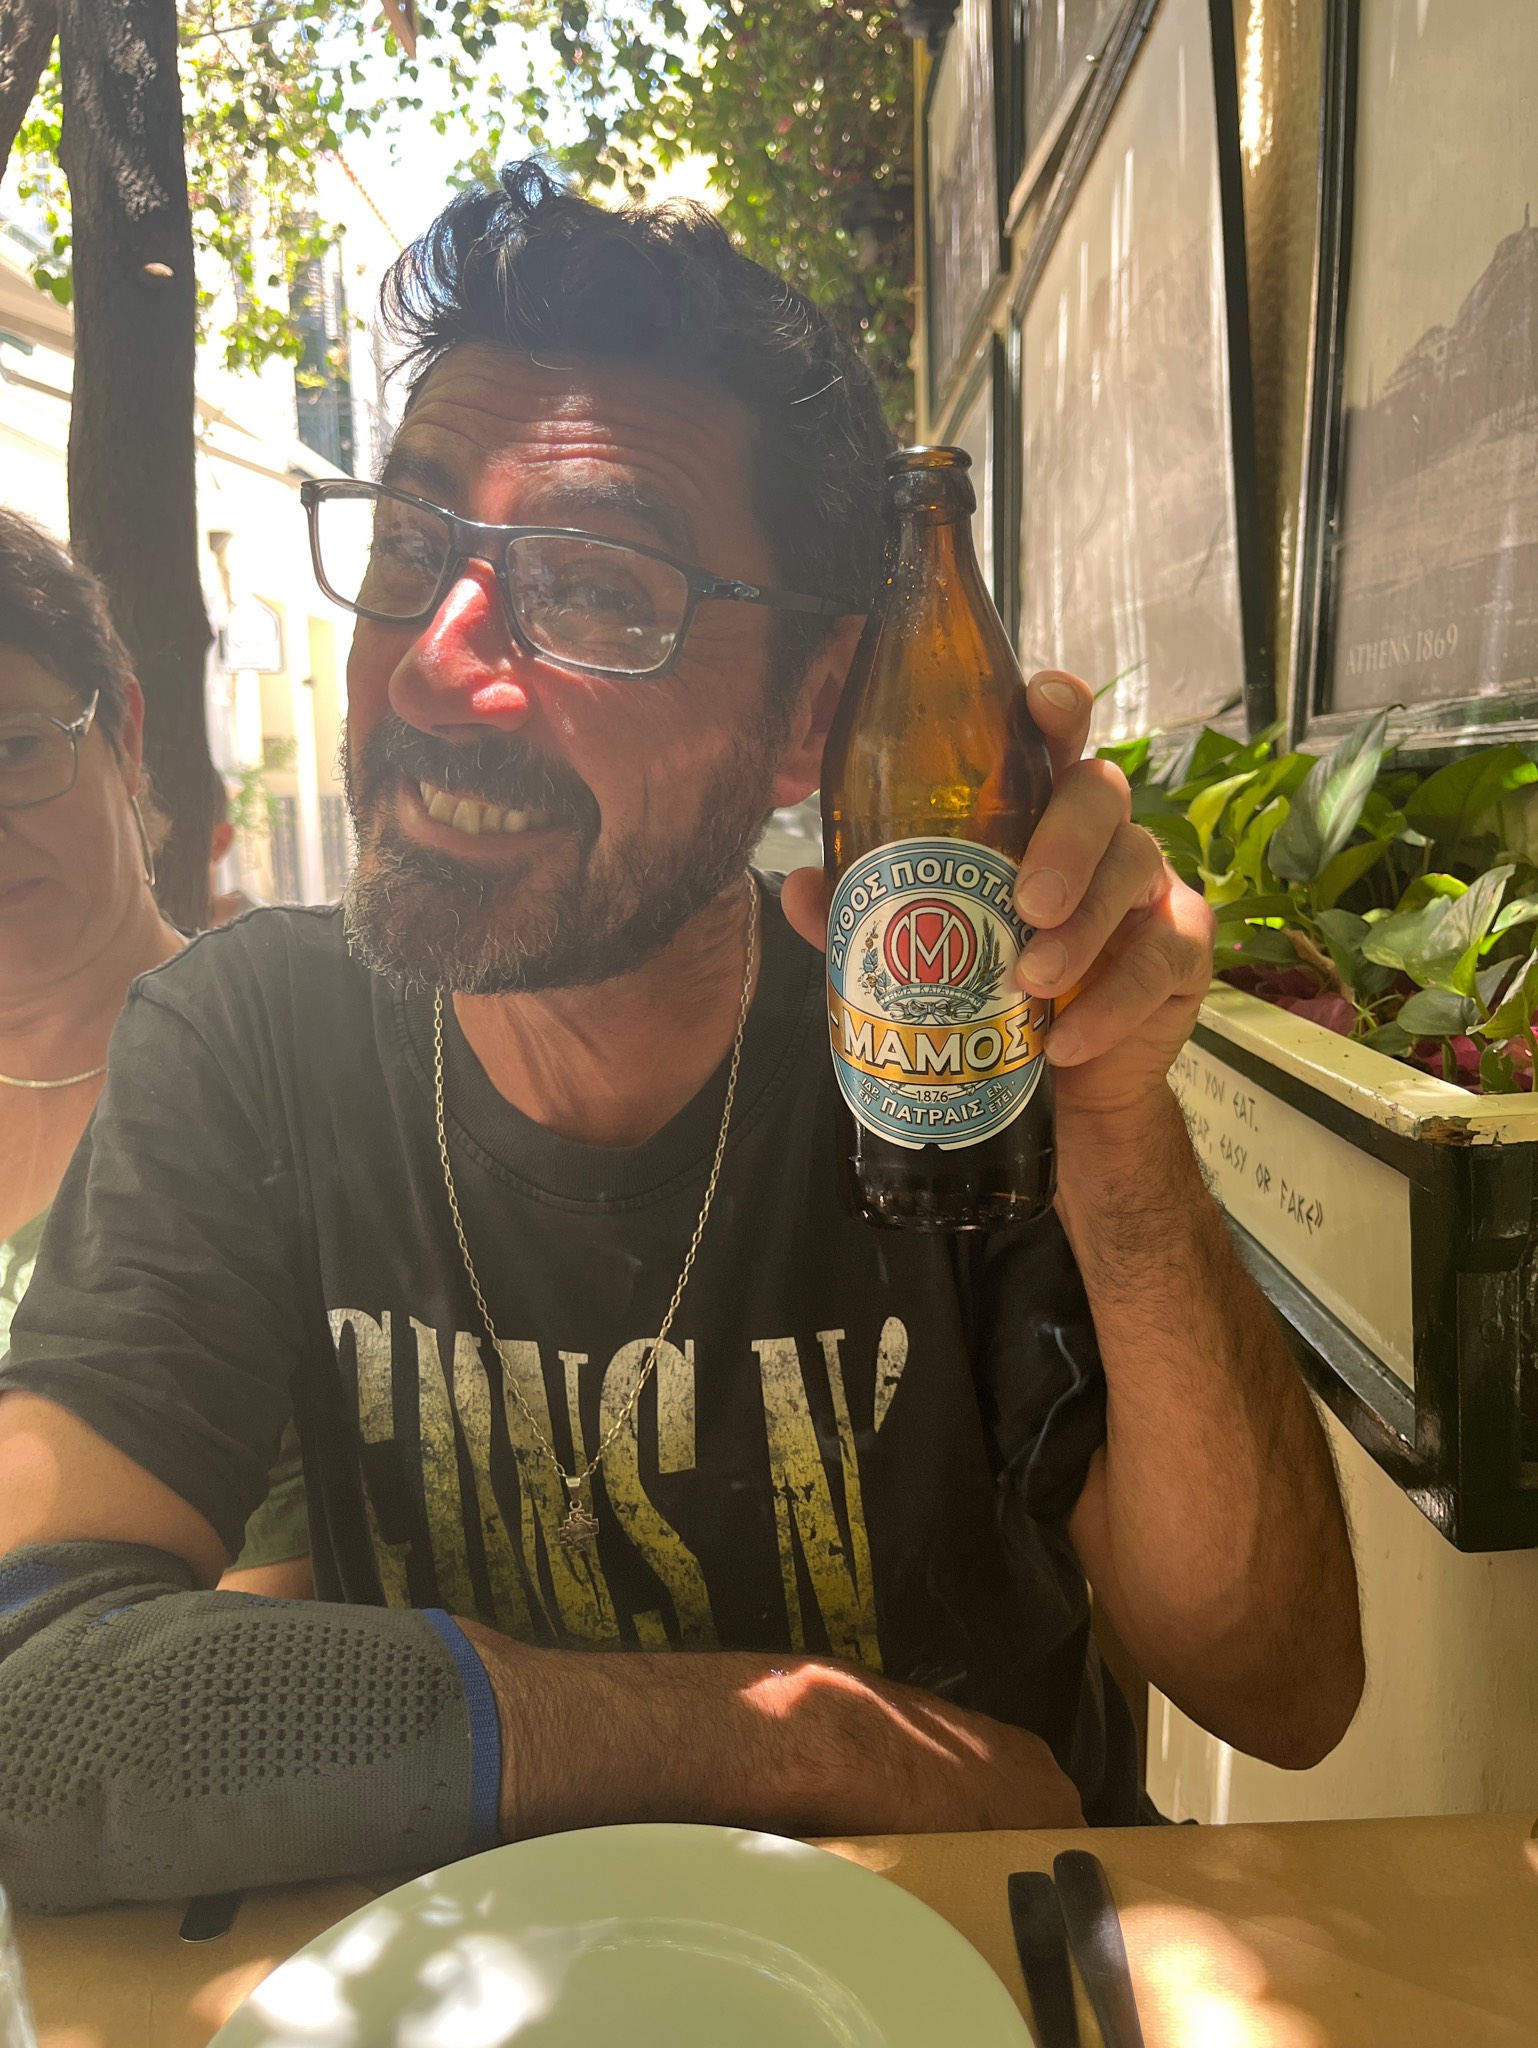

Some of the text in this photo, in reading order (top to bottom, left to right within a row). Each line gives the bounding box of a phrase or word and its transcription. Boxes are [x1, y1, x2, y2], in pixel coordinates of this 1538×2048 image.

[1345, 623, 1459, 676] ATHENS 1869
[830, 857, 1036, 971] ΖΥΘΟΣ ΠΟΙΟΤΗΟ
[843, 1007, 1031, 1076] ΜΑΜΟΣ
[1174, 1053, 1198, 1088] HAT
[880, 1097, 986, 1127] ΠΑΤΡΑΙΣ
[916, 1090, 949, 1104] 1876
[988, 1090, 1014, 1114] ΕΤΕΙ
[1220, 1133, 1247, 1174] EASY
[1255, 1162, 1272, 1195] OR
